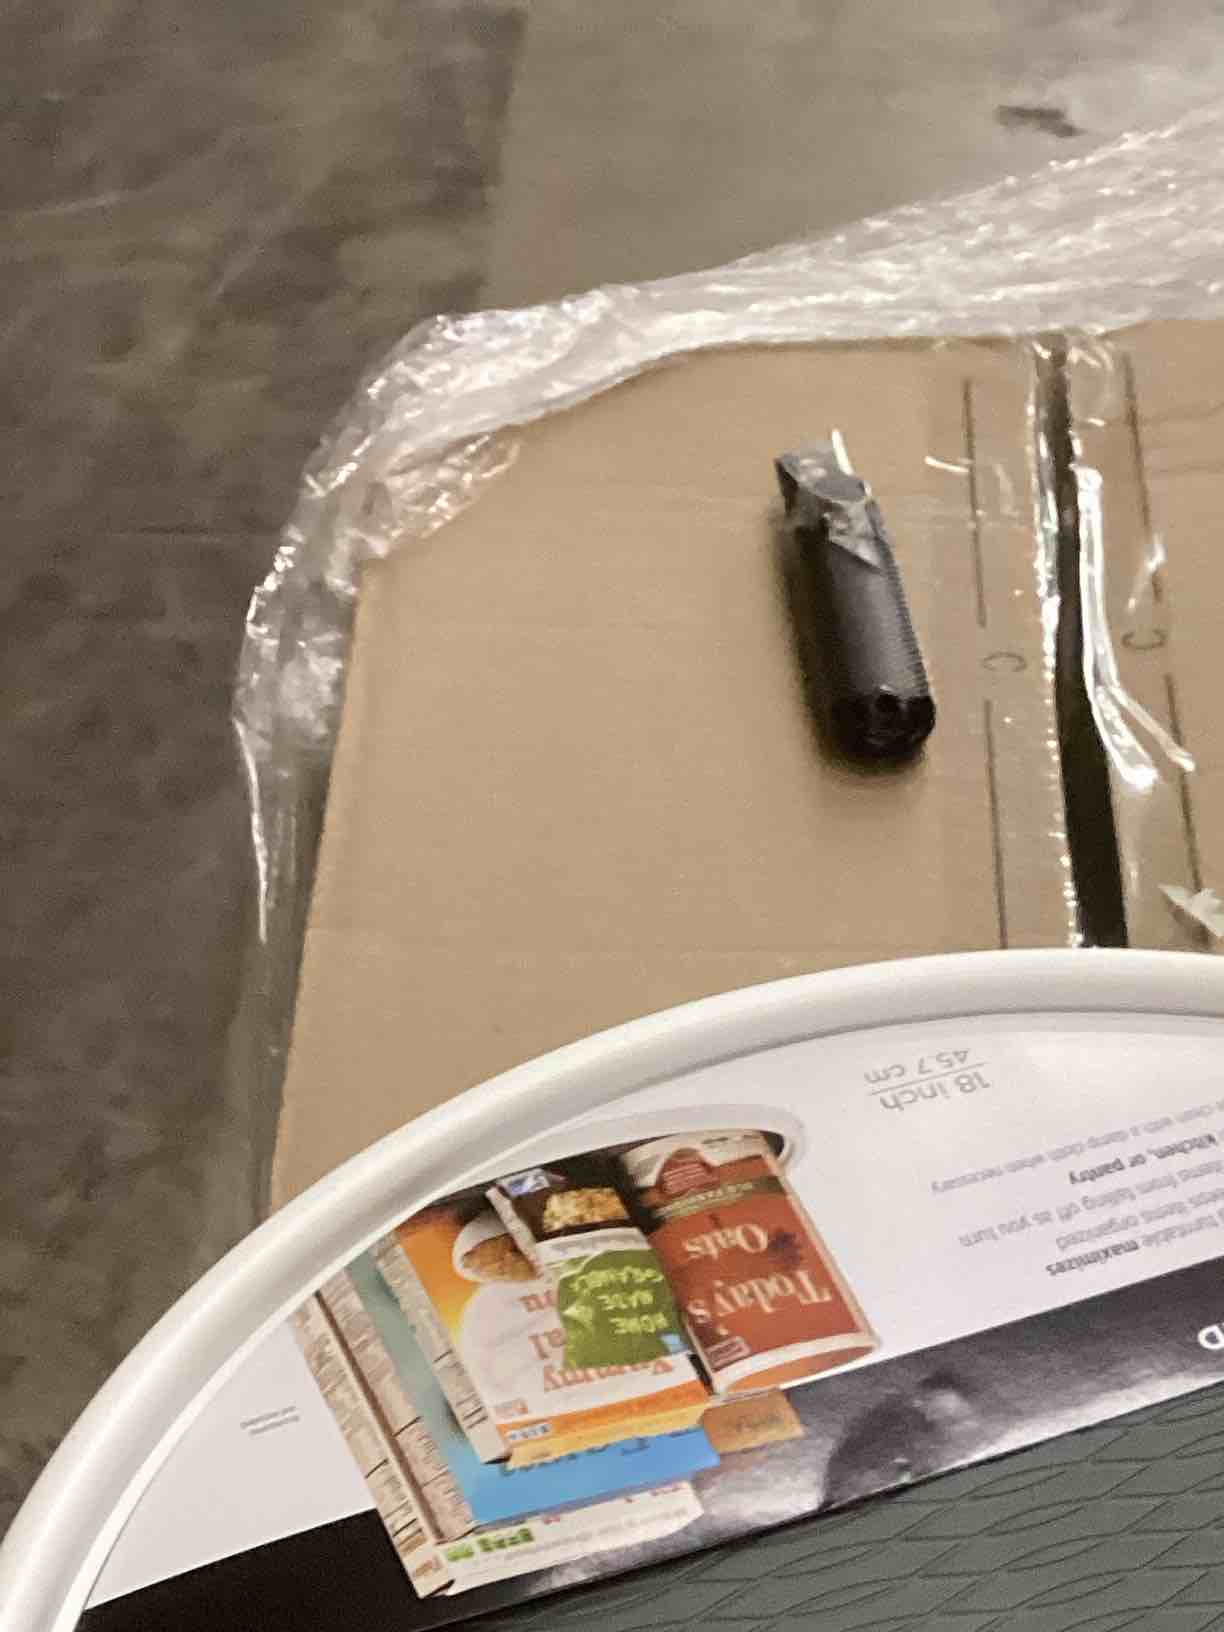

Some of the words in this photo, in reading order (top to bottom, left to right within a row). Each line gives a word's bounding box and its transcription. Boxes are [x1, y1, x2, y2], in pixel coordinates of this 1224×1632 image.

[864, 1064, 905, 1084] cm
[954, 1071, 991, 1093] 18
[879, 1081, 951, 1111] inch
[1069, 1158, 1125, 1185] pantry
[682, 1223, 768, 1260] Oats
[1046, 1239, 1140, 1276] maximizes
[686, 1270, 832, 1336] Today's
